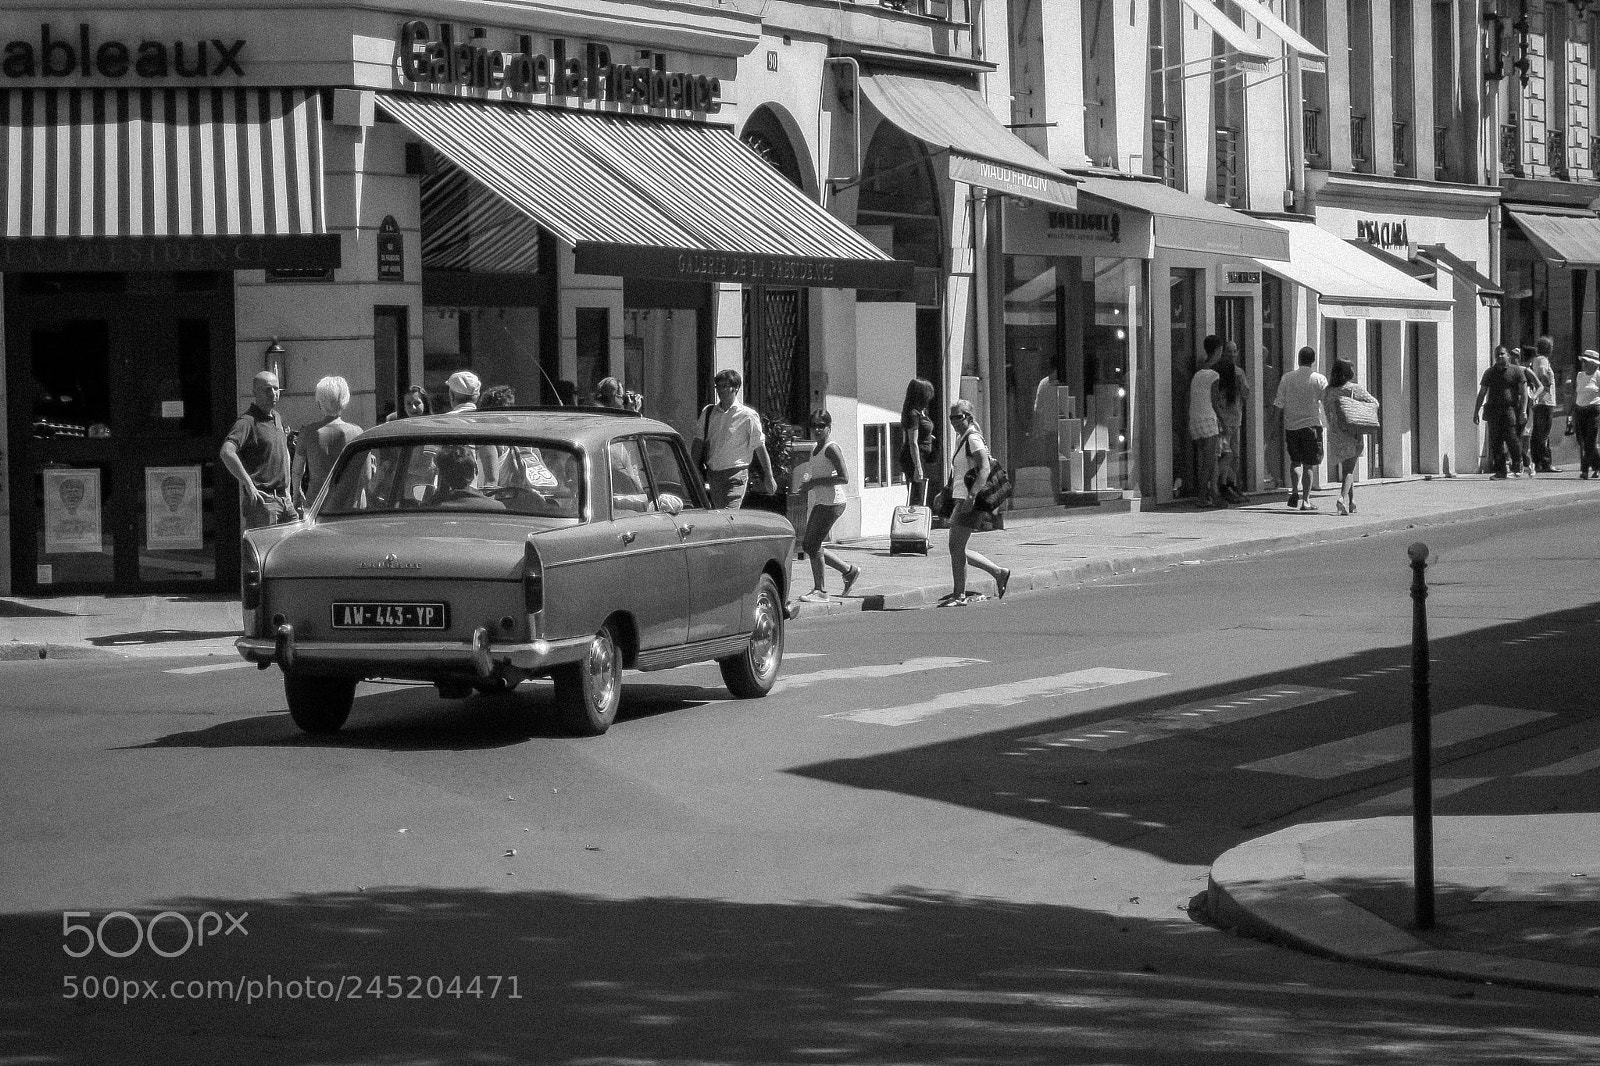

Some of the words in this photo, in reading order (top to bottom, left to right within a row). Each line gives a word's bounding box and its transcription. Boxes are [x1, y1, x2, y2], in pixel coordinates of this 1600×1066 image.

[2, 23, 247, 78] ableaux
[768, 53, 777, 70] 90
[400, 20, 504, 90] Galerie
[506, 34, 549, 93] de
[553, 39, 581, 97] la
[586, 42, 722, 114] Presidence
[980, 163, 1011, 182] MAUD
[678, 254, 726, 274] GALERIE
[733, 258, 746, 275] DE
[751, 260, 764, 277] LA
